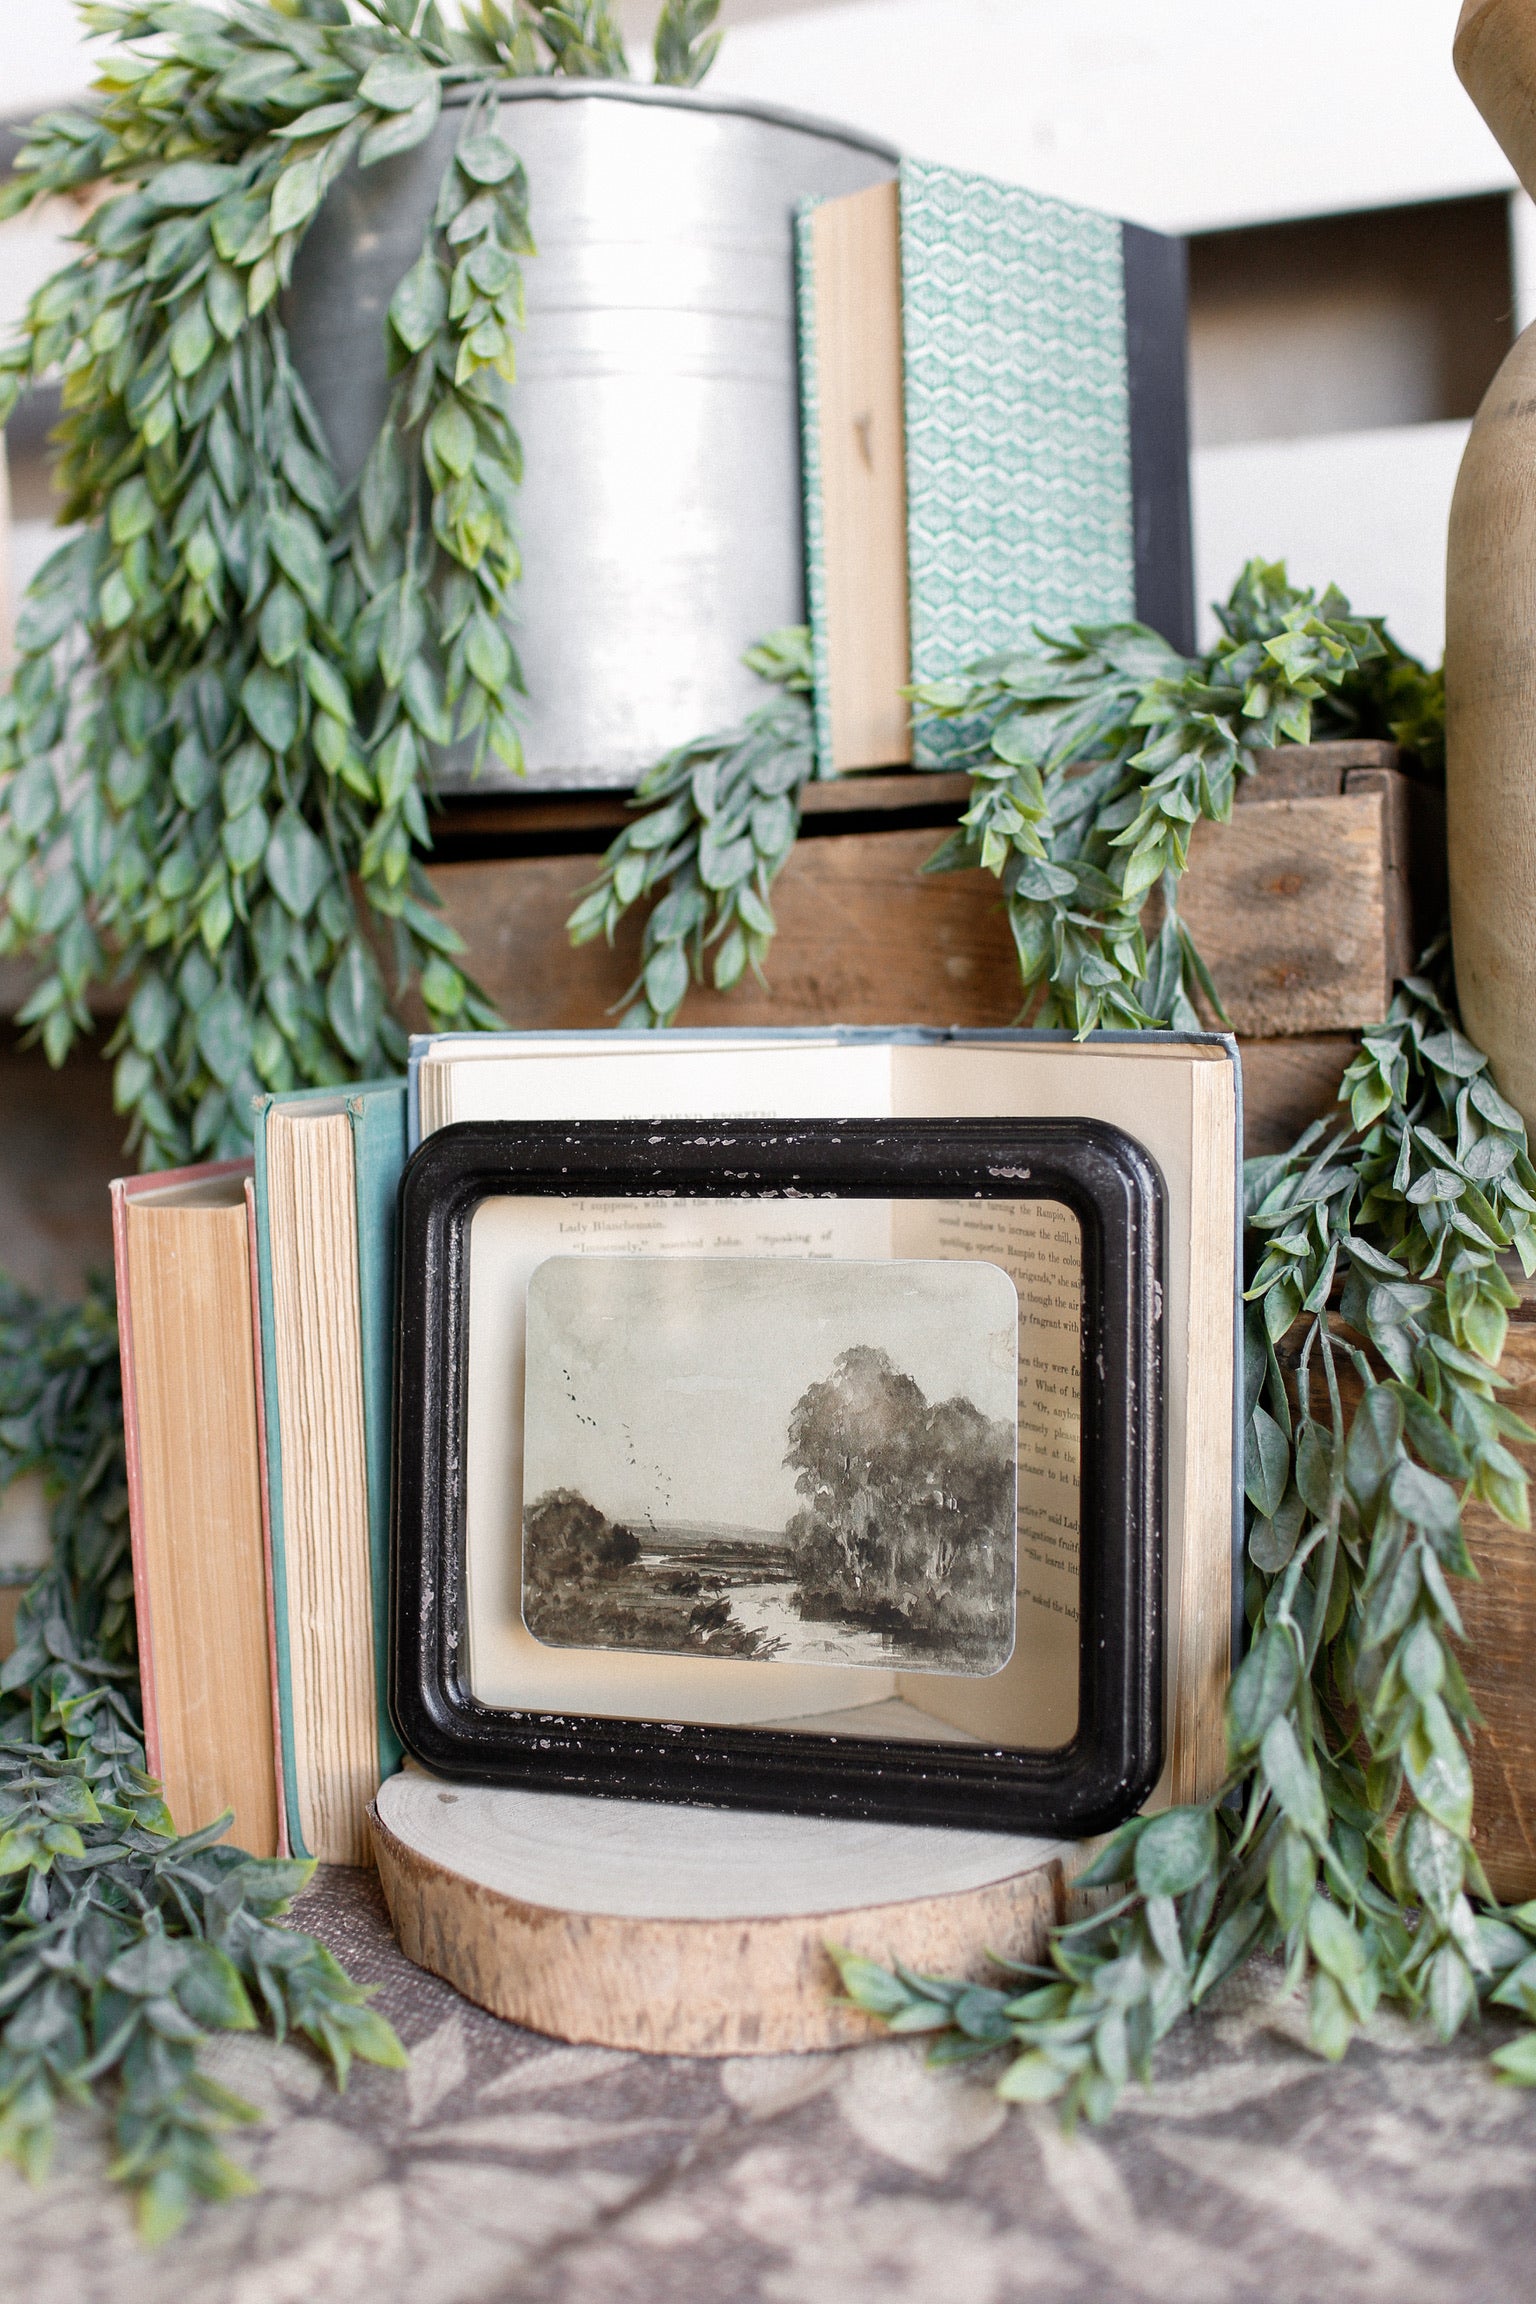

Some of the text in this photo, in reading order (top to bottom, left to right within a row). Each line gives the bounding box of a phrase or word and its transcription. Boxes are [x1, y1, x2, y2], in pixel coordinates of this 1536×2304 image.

[1020, 1203, 1032, 1216] the
[1036, 1205, 1066, 1222] Rampio,
[559, 1222, 588, 1234] Lady
[997, 1222, 1006, 1233] to
[1008, 1223, 1037, 1239] increase
[1039, 1227, 1051, 1240] the
[1054, 1230, 1072, 1246] chill,
[1007, 1244, 1036, 1260] Rampio
[1038, 1249, 1046, 1261] to
[1048, 1251, 1060, 1264] the
[1057, 1274, 1070, 1288] she
[1027, 1291, 1053, 1309] though
[1054, 1296, 1067, 1309] the
[1068, 1299, 1080, 1311] air
[1029, 1313, 1061, 1330] fragrant
[1062, 1320, 1079, 1334] with
[1032, 1356, 1049, 1374] they
[1051, 1363, 1069, 1375] were
[1035, 1378, 1057, 1394] What
[1059, 1385, 1069, 1397] of
[1034, 1442, 1047, 1456] but
[1051, 1449, 1060, 1459] at
[1064, 1450, 1076, 1464] the
[1048, 1467, 1056, 1480] to
[1060, 1470, 1069, 1484] let
[1048, 1513, 1062, 1526] said
[1032, 1594, 1051, 1609] asked
[1052, 1600, 1064, 1614] the
